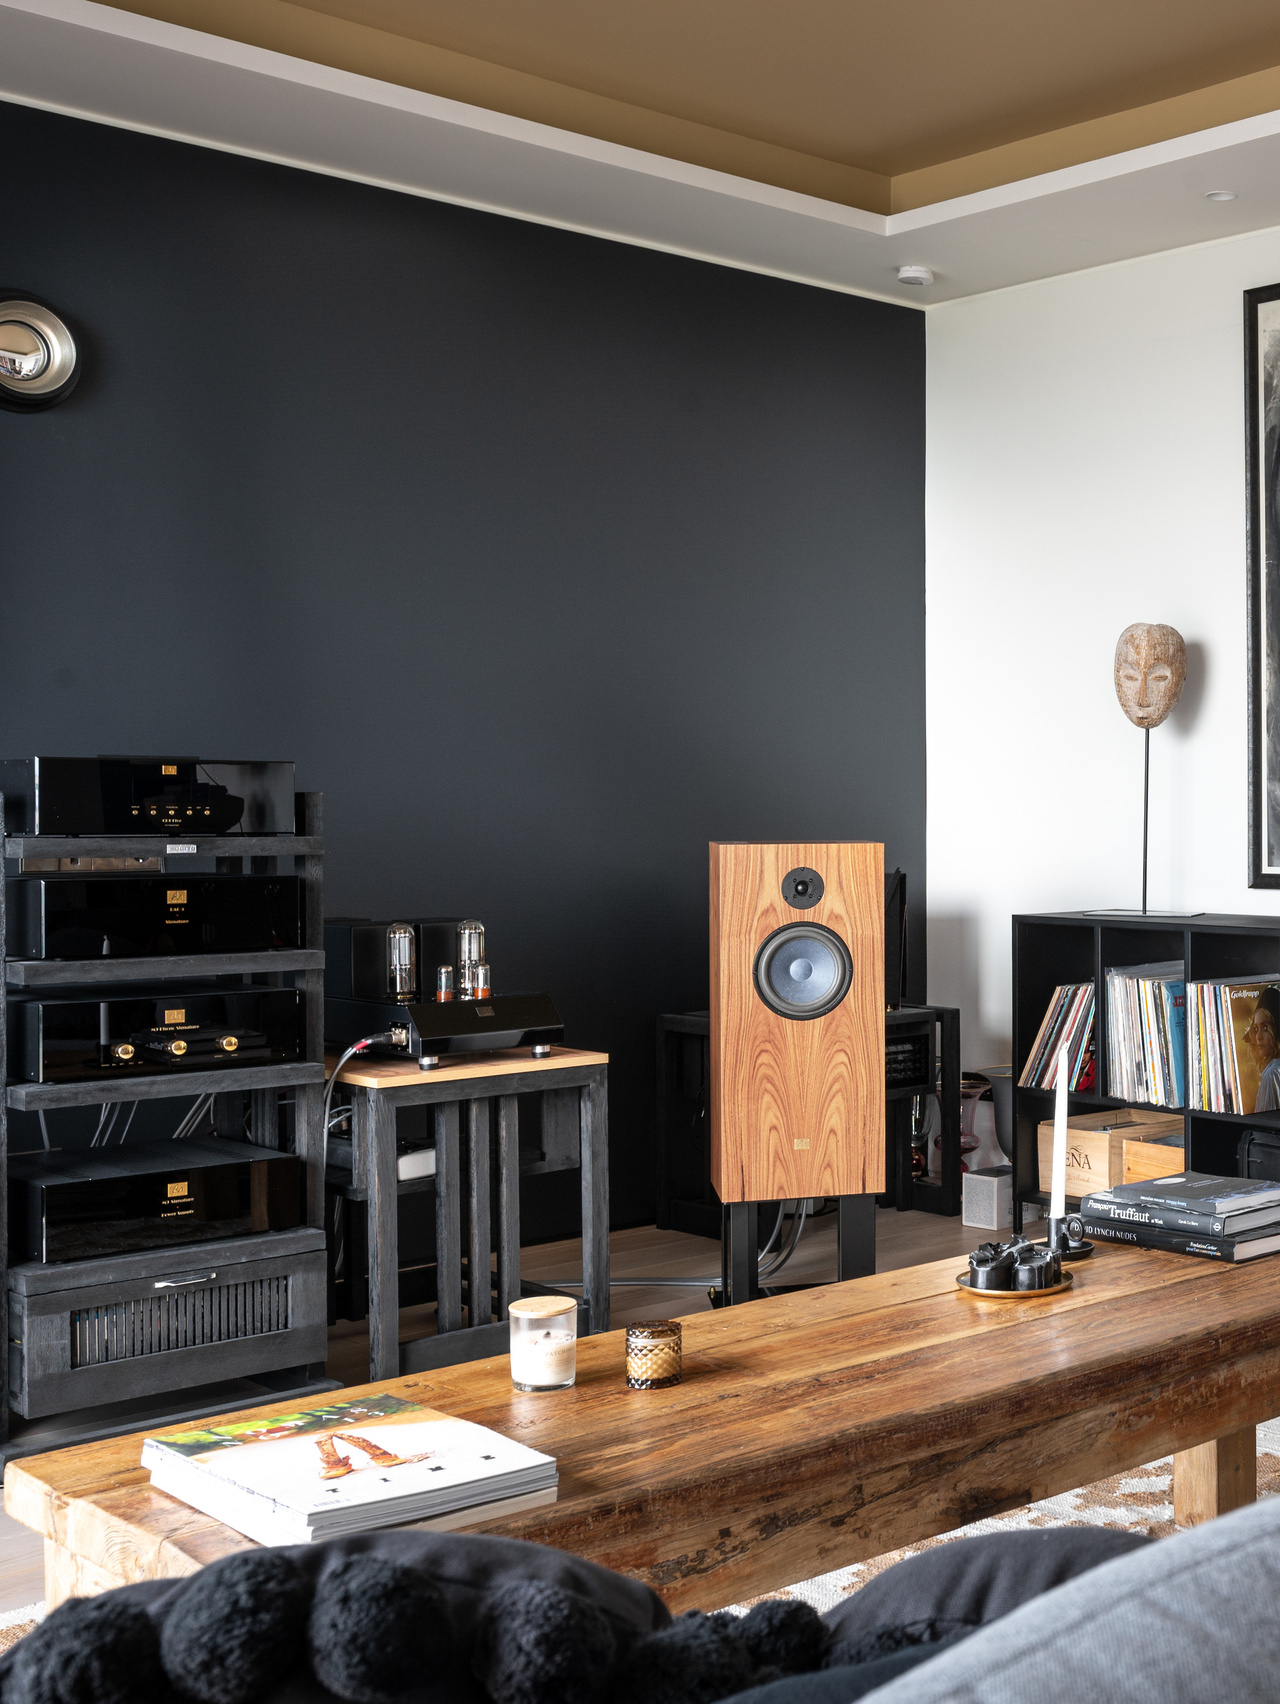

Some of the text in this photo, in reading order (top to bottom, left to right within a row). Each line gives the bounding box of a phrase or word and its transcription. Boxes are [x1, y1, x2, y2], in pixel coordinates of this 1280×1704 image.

[1230, 989, 1260, 999] Goldfrapp
[1087, 1199, 1150, 1222] François Truffaut
[1074, 1223, 1137, 1241] DVID LYNCH NUDES
